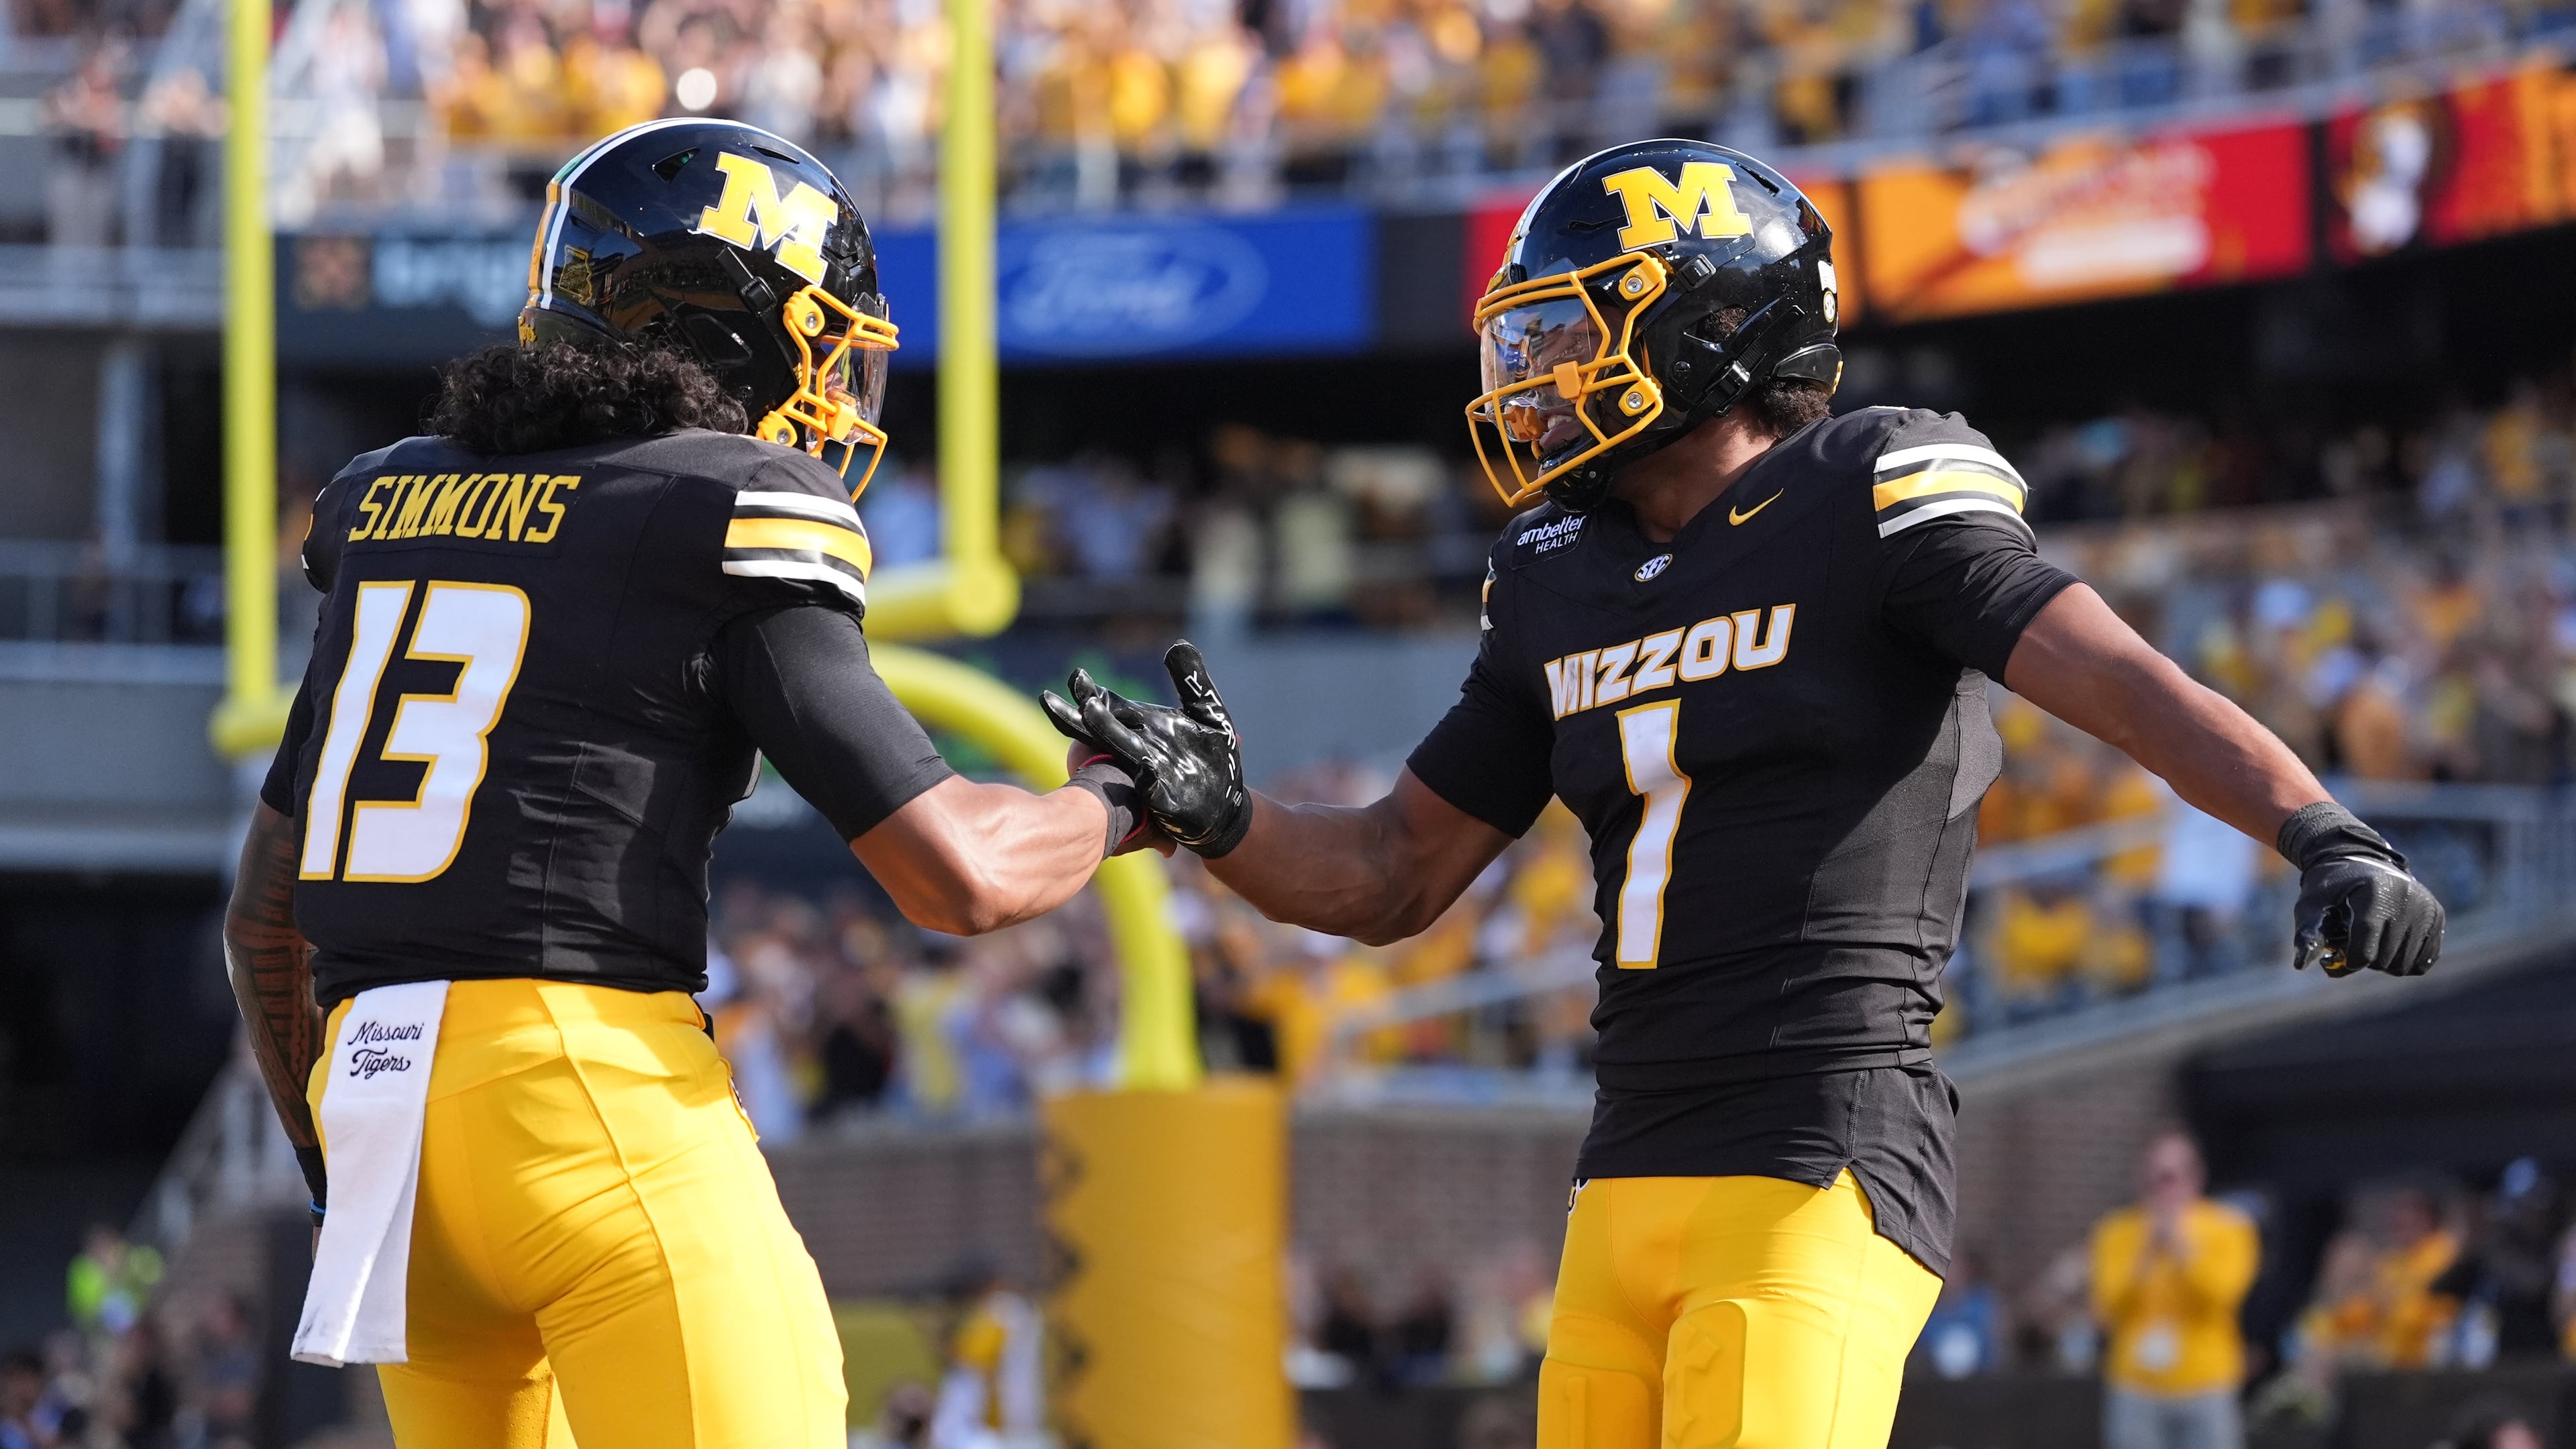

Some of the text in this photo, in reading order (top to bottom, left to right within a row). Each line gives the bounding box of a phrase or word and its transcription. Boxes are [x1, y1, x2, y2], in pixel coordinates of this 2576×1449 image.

[697, 152, 838, 286] M
[1602, 162, 1754, 253] M
[348, 474, 581, 543] SIMMONS
[1517, 515, 1587, 546] ambetter
[1535, 531, 1578, 555] HEALTH
[1636, 554, 1670, 580] SEC
[1544, 603, 1796, 721] MIZZOU
[299, 580, 531, 883] 13
[1616, 698, 1692, 969] 1
[347, 1021, 424, 1045] Missouri
[350, 1047, 411, 1079] Tigers
